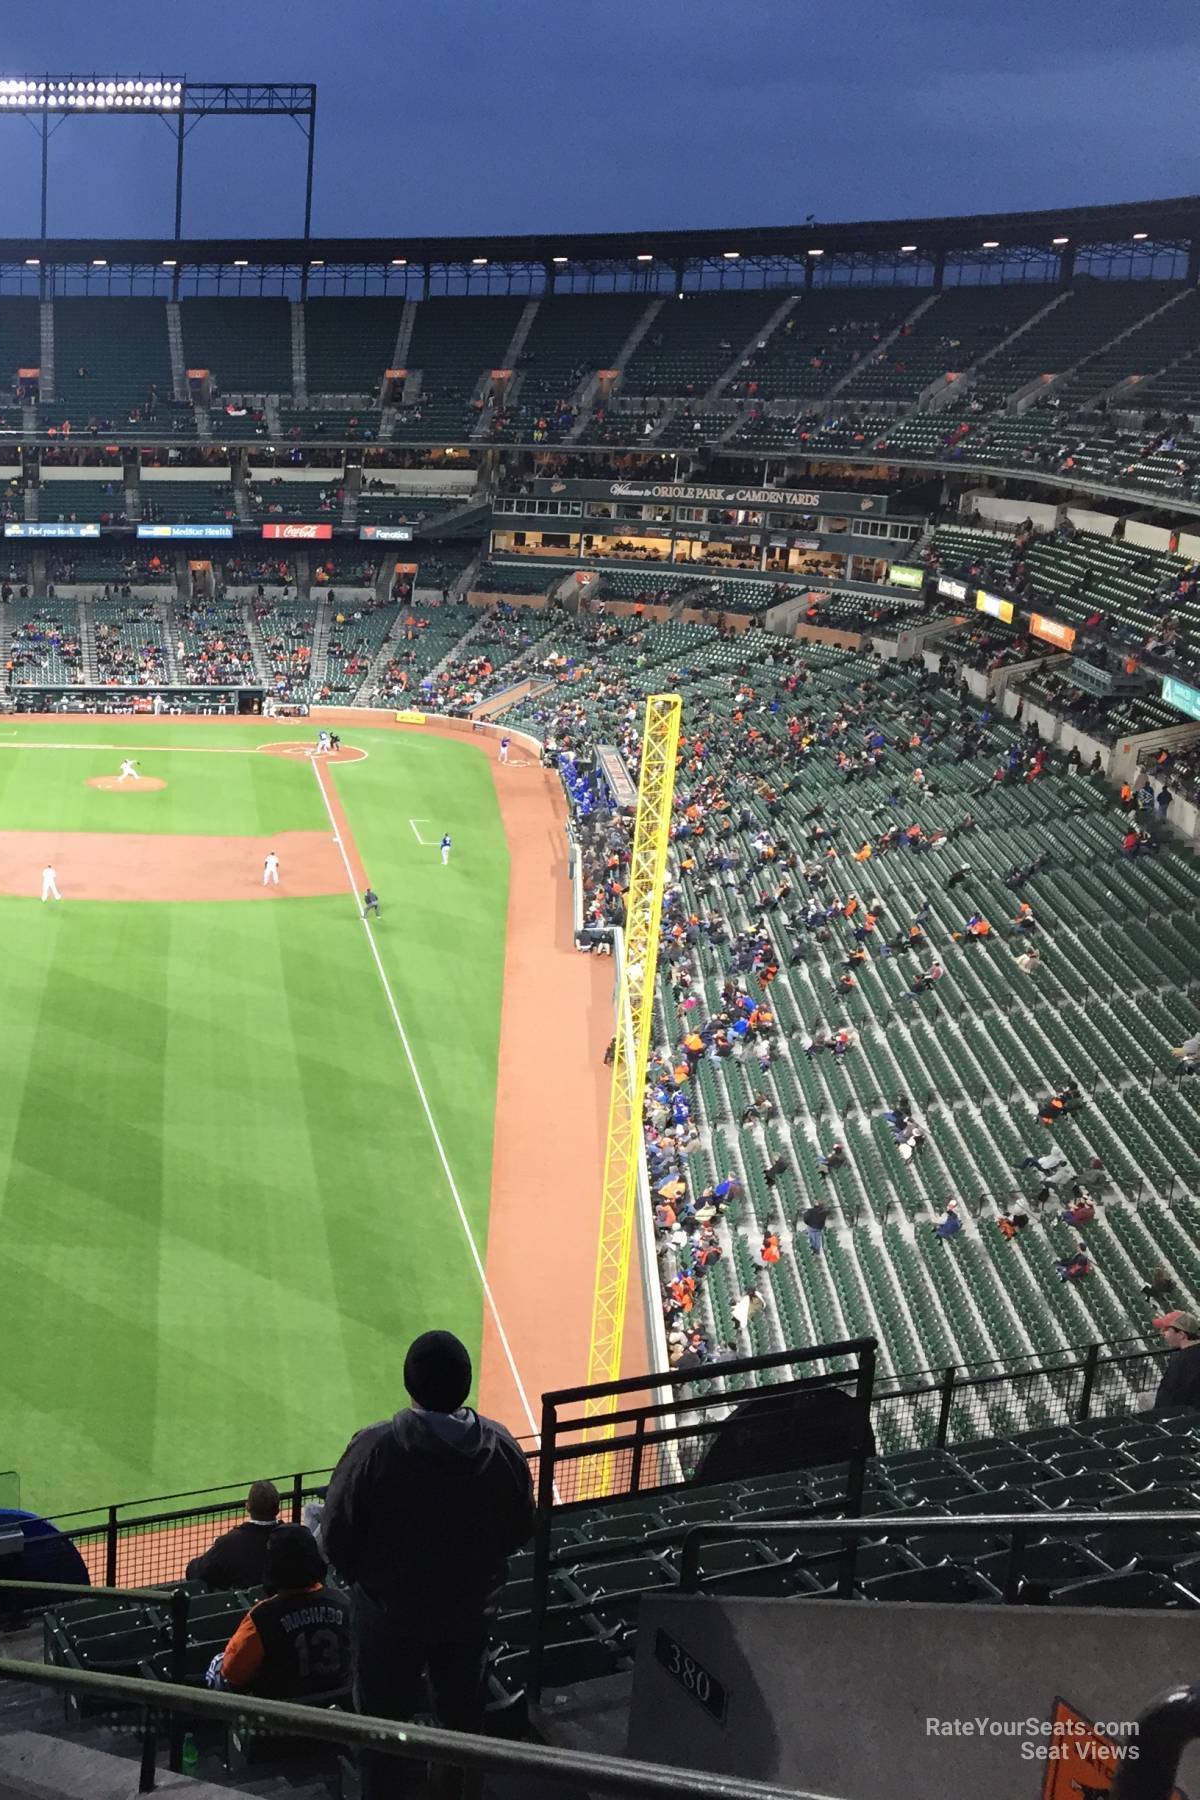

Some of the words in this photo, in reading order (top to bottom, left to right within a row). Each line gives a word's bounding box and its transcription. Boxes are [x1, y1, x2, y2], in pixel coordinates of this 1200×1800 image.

[610, 482, 644, 496] Welcome
[652, 485, 695, 498] ORIOLE
[695, 488, 725, 500] PARK
[736, 489, 784, 503] CAMDEN
[785, 492, 819, 506] YARDS
[172, 527, 204, 536] MedStar
[204, 527, 231, 536] Health
[375, 529, 409, 539] Fanatics
[295, 1629, 341, 1677] 13
[668, 1644, 710, 1701] 380
